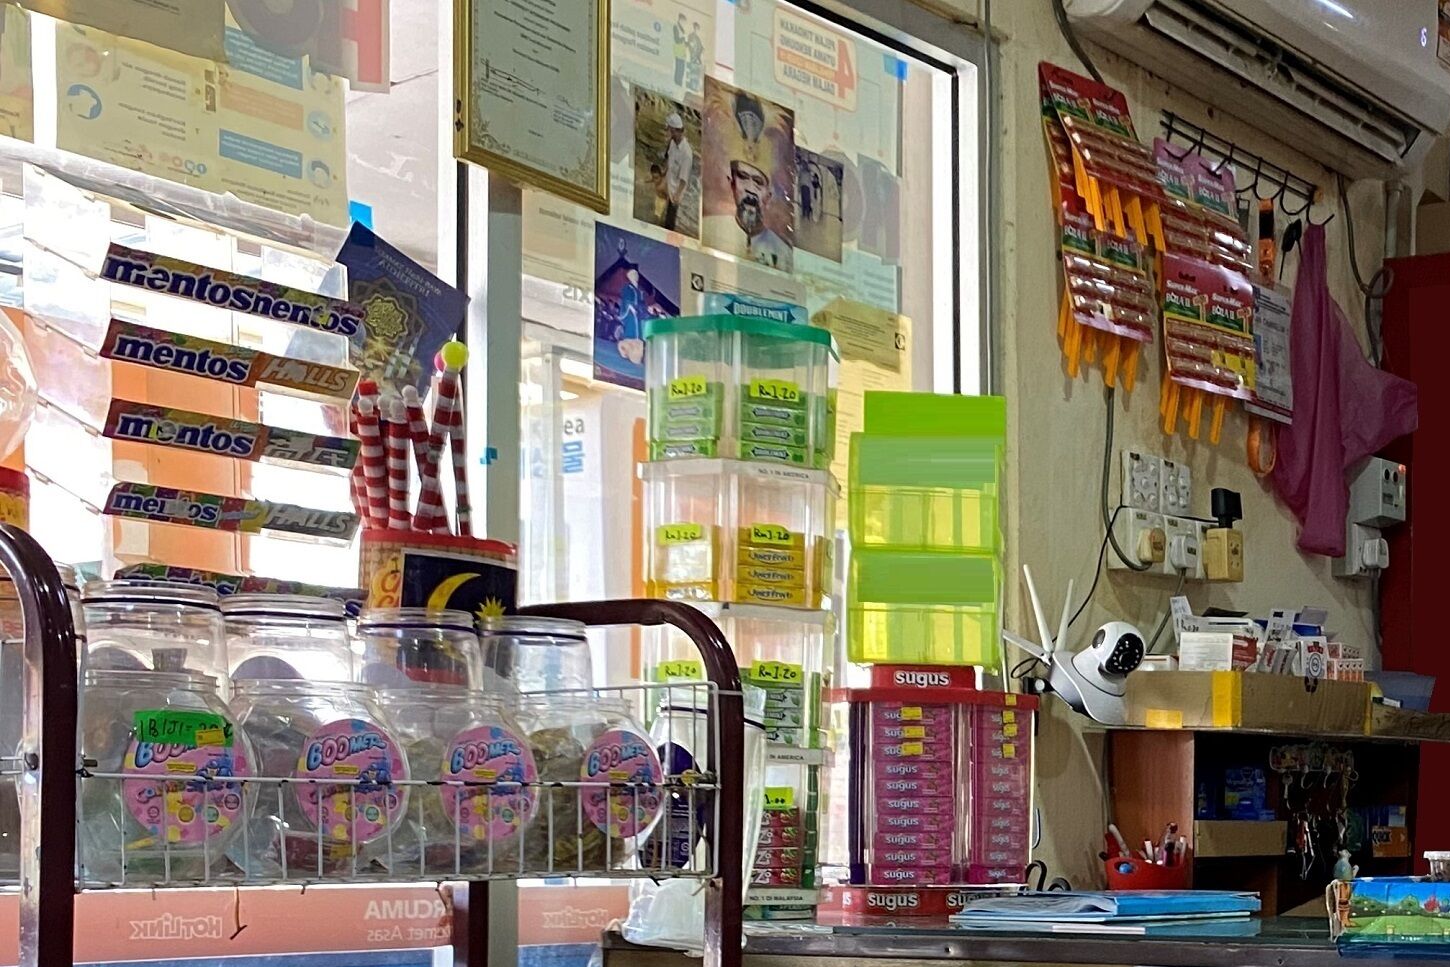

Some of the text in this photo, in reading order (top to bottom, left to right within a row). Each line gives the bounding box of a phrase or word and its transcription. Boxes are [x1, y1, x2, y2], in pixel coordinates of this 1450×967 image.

[102, 254, 255, 312] mentos
[113, 335, 250, 383] mentos
[265, 502, 353, 534] HALLS
[894, 670, 950, 687] sugus
[307, 733, 387, 771] BOOMER
[450, 739, 522, 774] BOOMER
[587, 743, 649, 777] BOOMER
[886, 765, 917, 776] sugus
[886, 781, 917, 792] sugus
[888, 799, 919, 811] sugus
[888, 817, 919, 828] sugus
[885, 835, 917, 846] sugus
[885, 853, 916, 863] sugus
[884, 870, 915, 881] sugus
[867, 892, 919, 910] sugus
